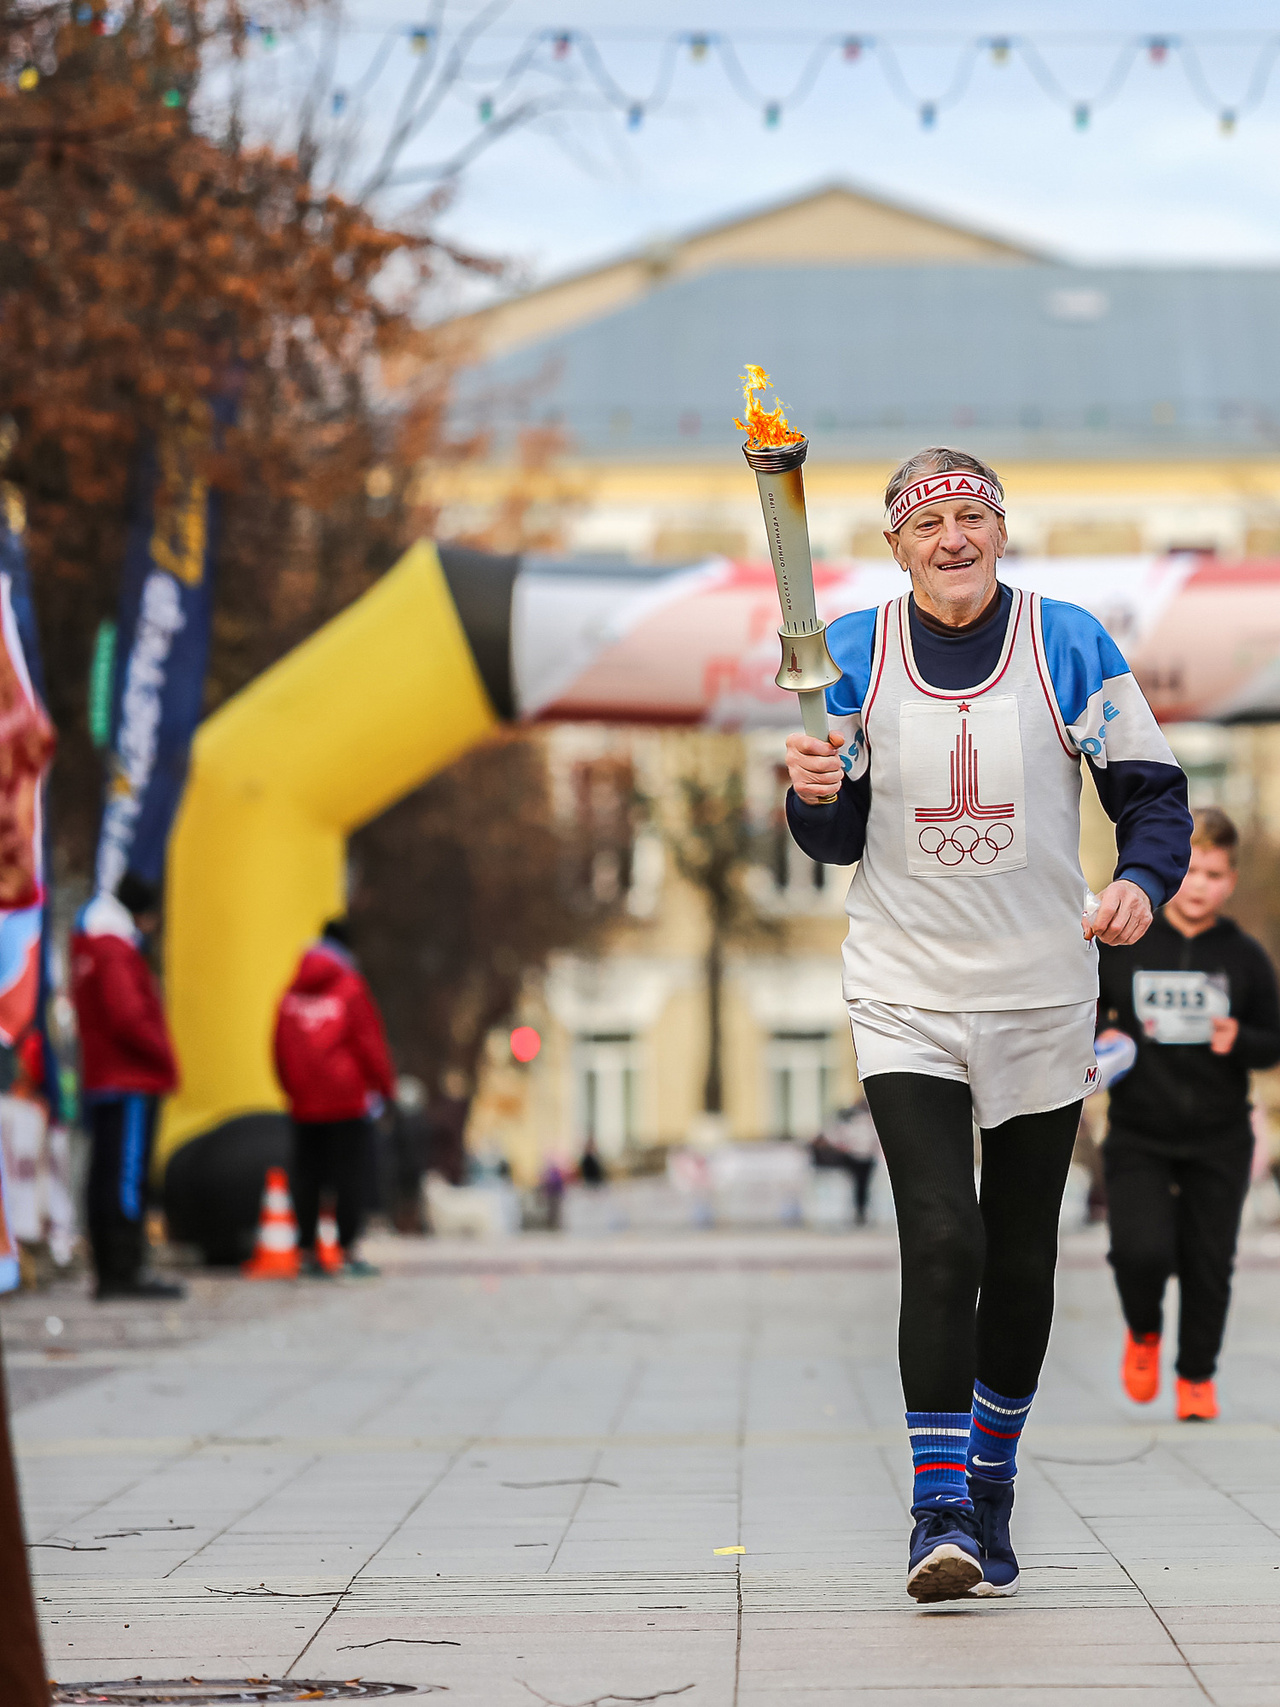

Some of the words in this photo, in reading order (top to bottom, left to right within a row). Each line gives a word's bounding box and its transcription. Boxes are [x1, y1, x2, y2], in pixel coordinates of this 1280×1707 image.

[768, 492, 776, 509] 1980
[773, 516, 786, 568] ОЛИМПИАДА
[783, 575, 793, 611] МОСКВА
